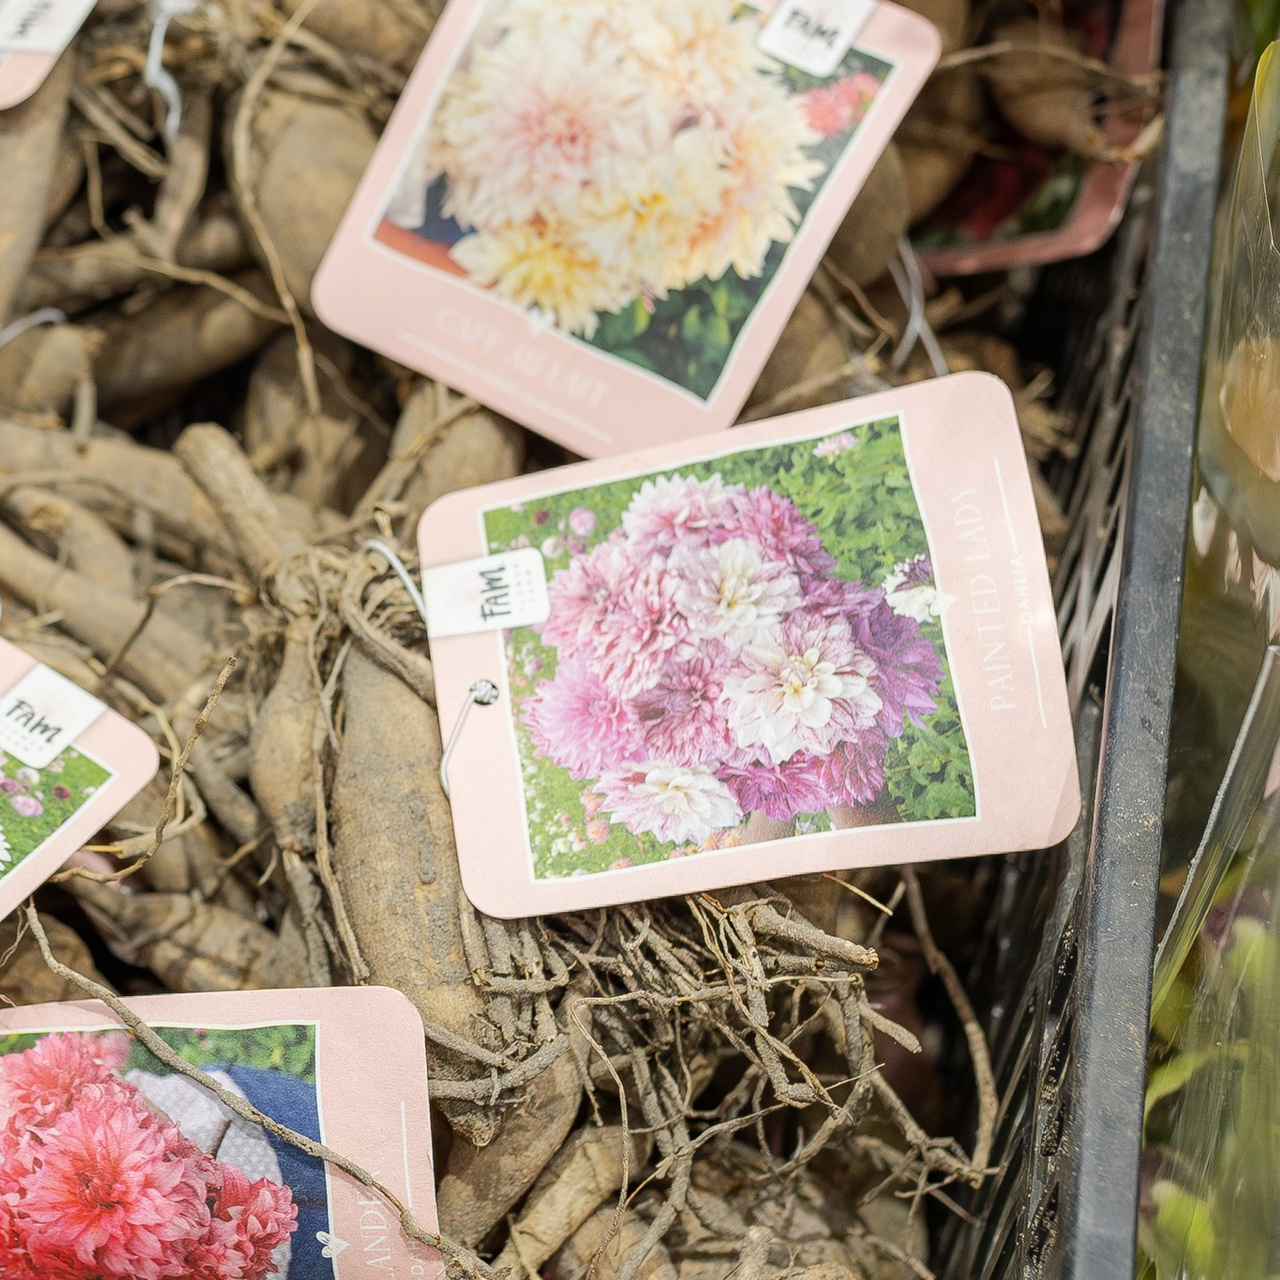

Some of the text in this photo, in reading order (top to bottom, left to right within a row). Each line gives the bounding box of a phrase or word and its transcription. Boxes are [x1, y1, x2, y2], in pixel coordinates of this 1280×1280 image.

[950, 488, 1017, 712] PAINTED LADY
[1010, 554, 1033, 625] DAHLIA
